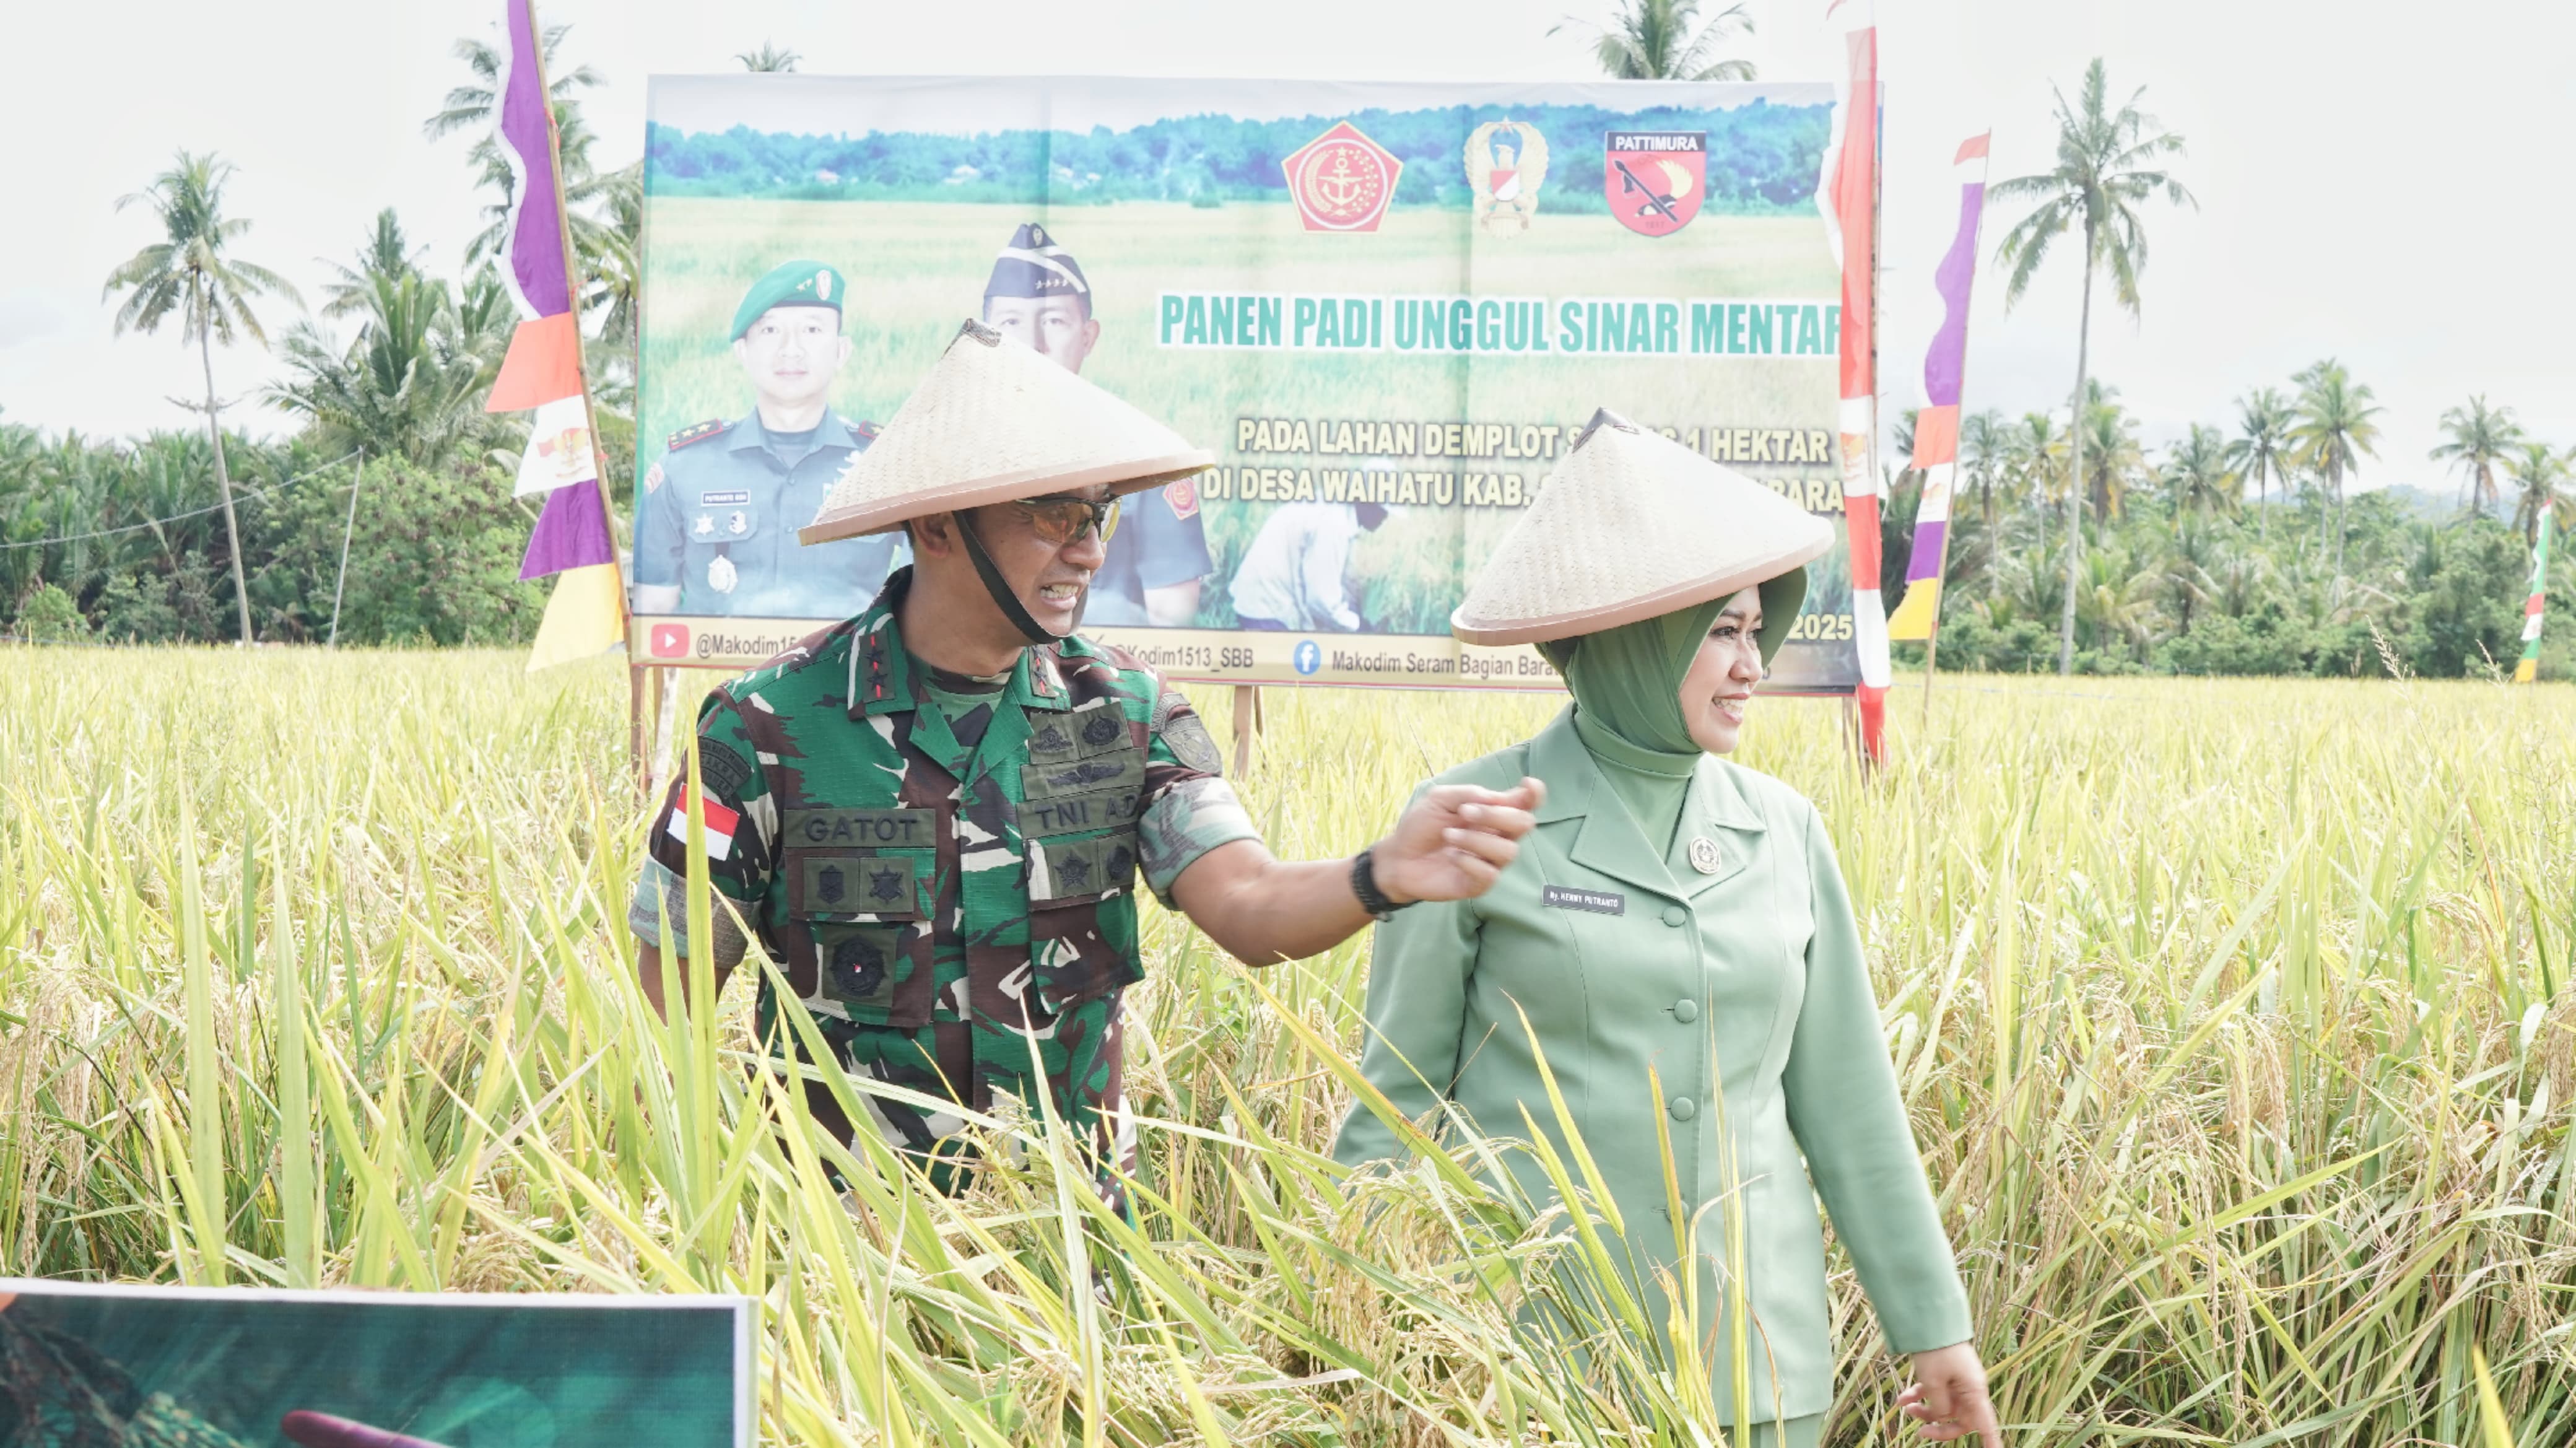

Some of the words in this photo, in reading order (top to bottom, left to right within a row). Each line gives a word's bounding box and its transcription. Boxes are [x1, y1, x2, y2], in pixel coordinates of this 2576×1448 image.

[1615, 135, 1699, 151] PATTIMURA
[1160, 295, 1282, 346] PANEN
[1294, 297, 1383, 348] PADI
[1394, 299, 1549, 351] UNGGUL
[1559, 301, 1679, 353] SINAR
[1691, 303, 1841, 355] MENTAR
[1238, 419, 1311, 452] PADA
[1319, 421, 1416, 455] LAHAN
[1425, 424, 1560, 458] DEMPLOT
[1711, 429, 1830, 462] HEKTAR
[1203, 468, 1230, 499] DI
[1240, 469, 1315, 501] DESA
[1321, 471, 1453, 505] WAIHATU
[1463, 474, 1531, 507] KAB.
[1767, 479, 1846, 512] ARA
[1787, 614, 1853, 640] 2025
[696, 634, 803, 659] @Makodim15
[1332, 651, 1401, 673] Makodim
[1406, 652, 1455, 674] Seram
[1460, 653, 1513, 680] Bagian
[1518, 654, 1558, 676] Bara
[806, 814, 918, 842] GATOT
[1035, 800, 1090, 830] TNI
[1549, 891, 1560, 902] Ny.
[1560, 892, 1583, 904] HENNY
[1585, 895, 1619, 908] PUTRANTO
